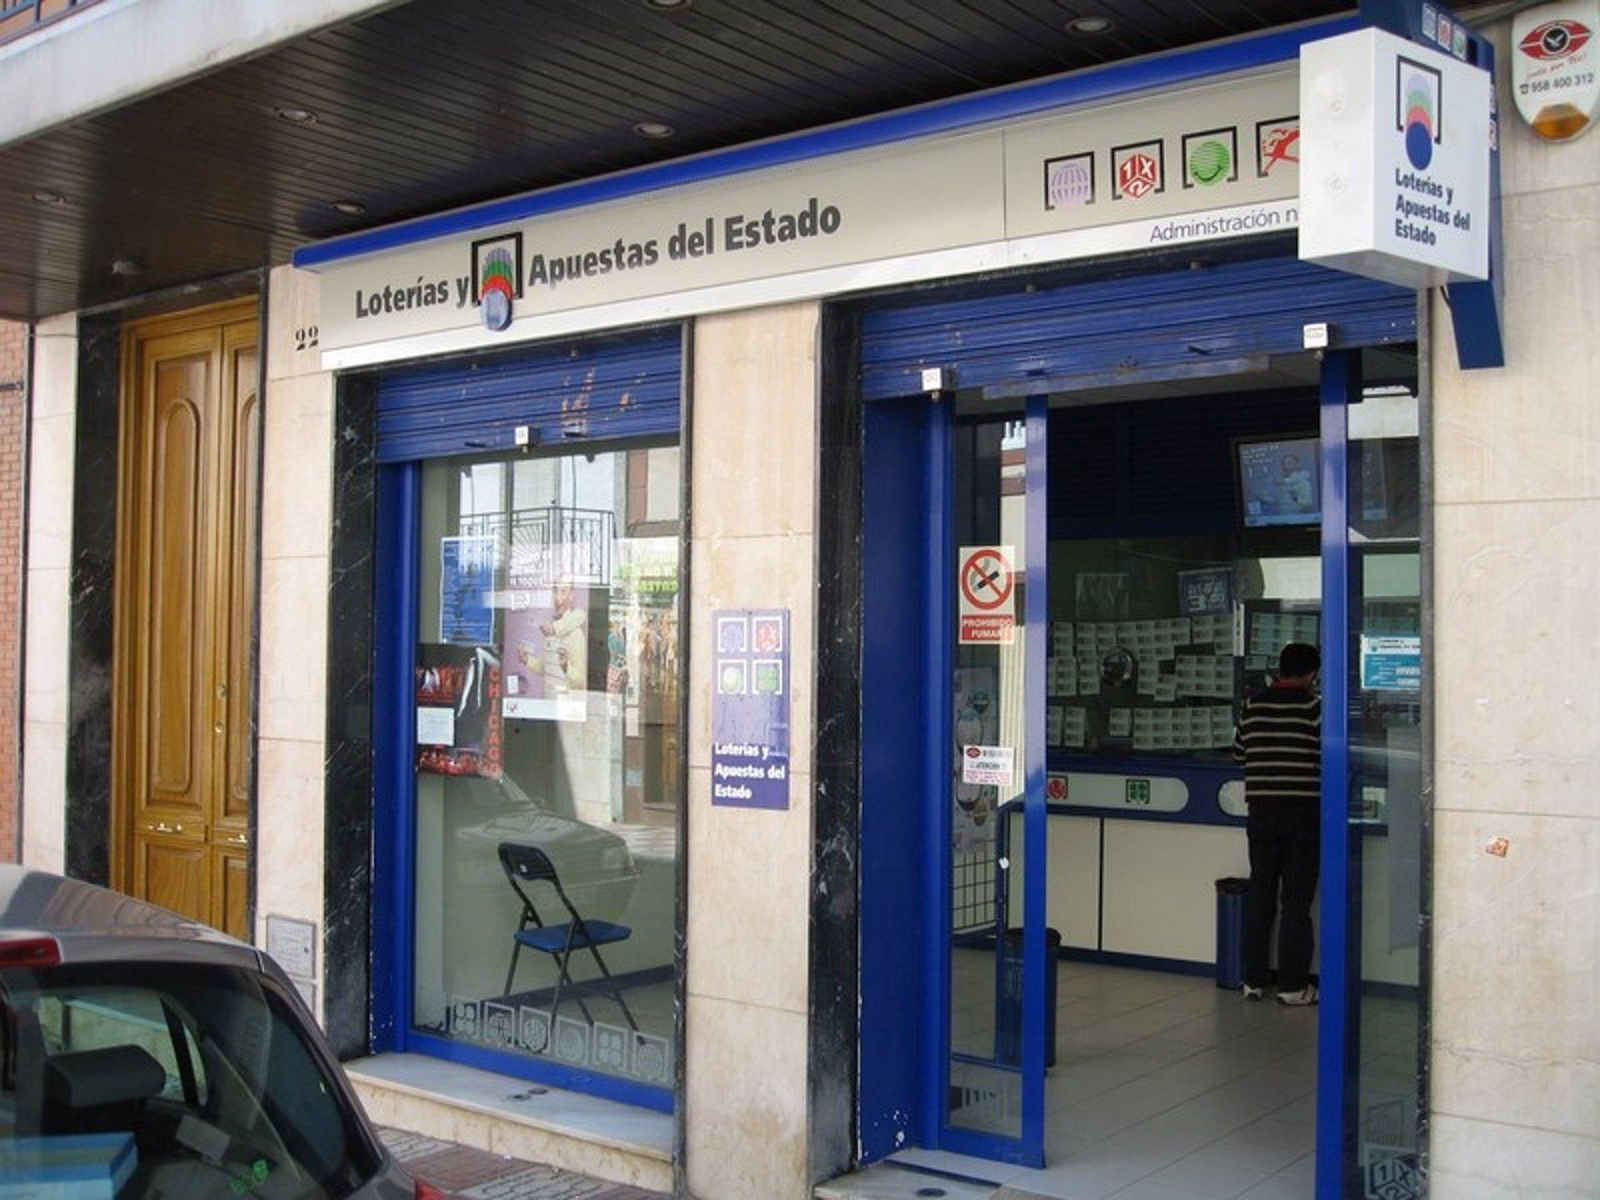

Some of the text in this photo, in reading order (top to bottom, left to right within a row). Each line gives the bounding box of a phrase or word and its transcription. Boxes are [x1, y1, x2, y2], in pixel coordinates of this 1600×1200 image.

[1445, 187, 1454, 205] y
[1150, 210, 1280, 242] Administración
[1395, 194, 1471, 231] Apuestas del
[528, 197, 842, 286] Apuestas del Estado
[1395, 219, 1436, 246] Estado
[355, 275, 470, 319] Loterías y
[294, 325, 319, 351] 22
[715, 762, 785, 780] Apuestas del
[715, 784, 752, 799] Estado
